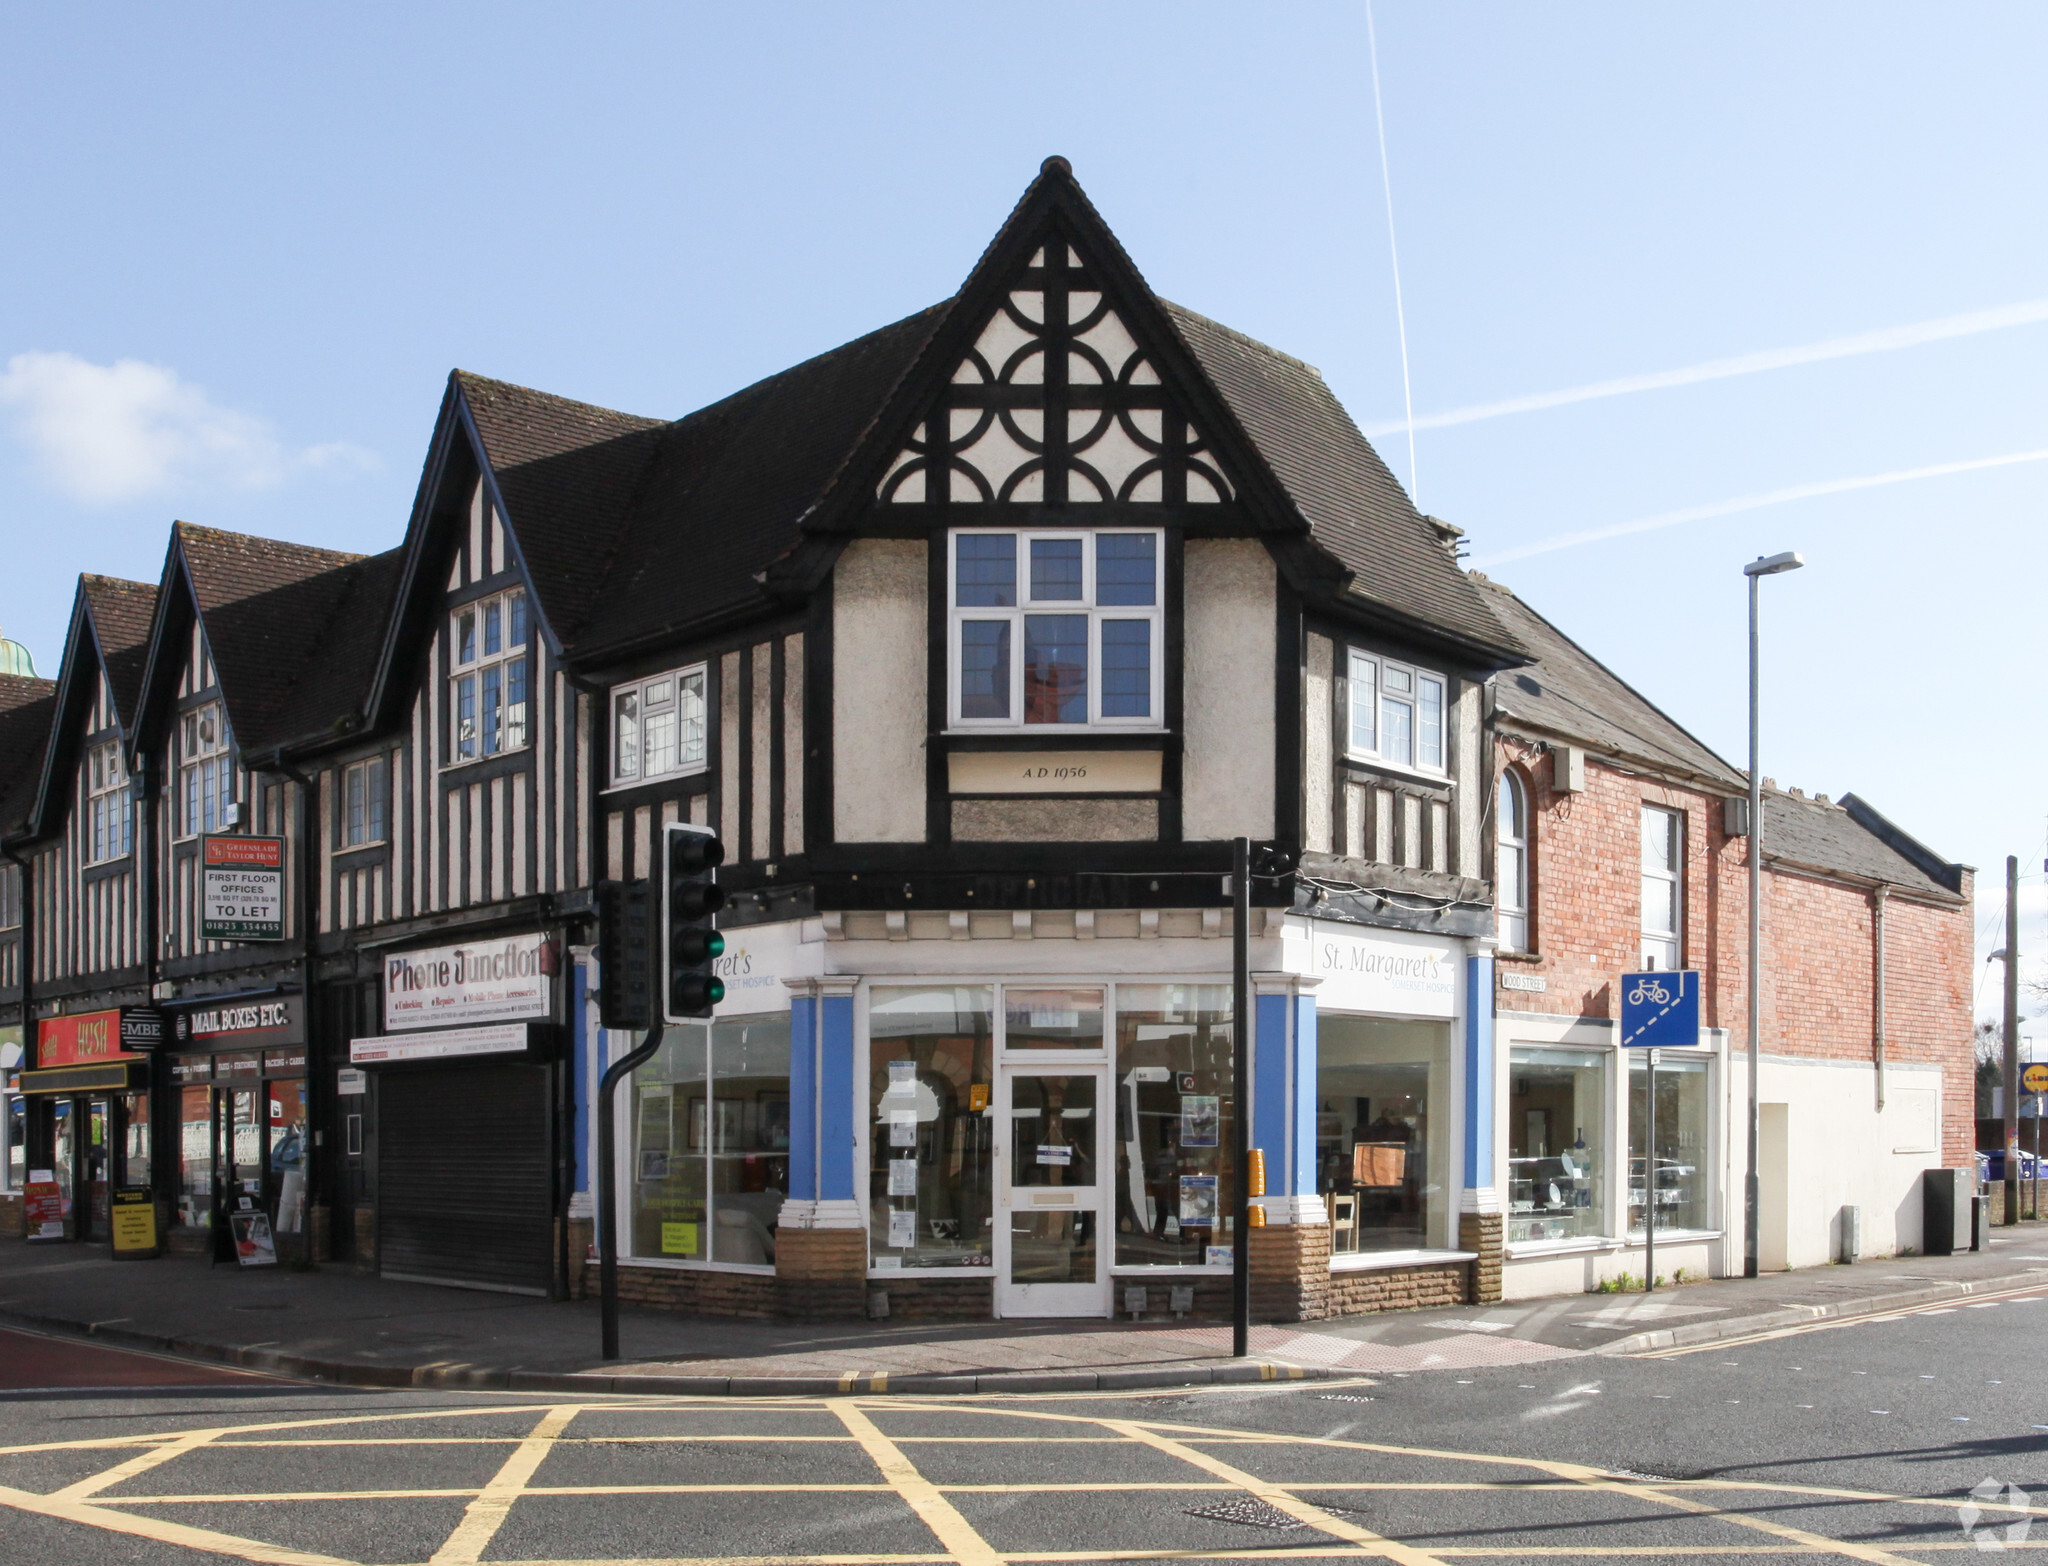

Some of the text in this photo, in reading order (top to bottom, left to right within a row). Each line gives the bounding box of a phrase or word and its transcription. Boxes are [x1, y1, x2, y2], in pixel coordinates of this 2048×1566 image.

[1054, 765, 1087, 780] 1956
[226, 843, 278, 853] GREENSLADE
[227, 851, 278, 861] TAYLOR HUNT
[209, 873, 276, 883] FIRST FLOOR
[221, 885, 264, 894] OFFICES
[215, 905, 269, 918] TO LET
[206, 921, 279, 932] 01823 334455
[388, 943, 541, 994] Phone Junction
[713, 949, 752, 977] ret's
[1322, 942, 1440, 981] St. Margaret's
[742, 975, 776, 989] HOSPICE
[1391, 979, 1455, 994] SOMERSET HOSPICE
[1503, 974, 1544, 990] WOOD STREET
[191, 1002, 289, 1035] MAIL BOXES ETC.
[127, 1023, 161, 1036] MBE
